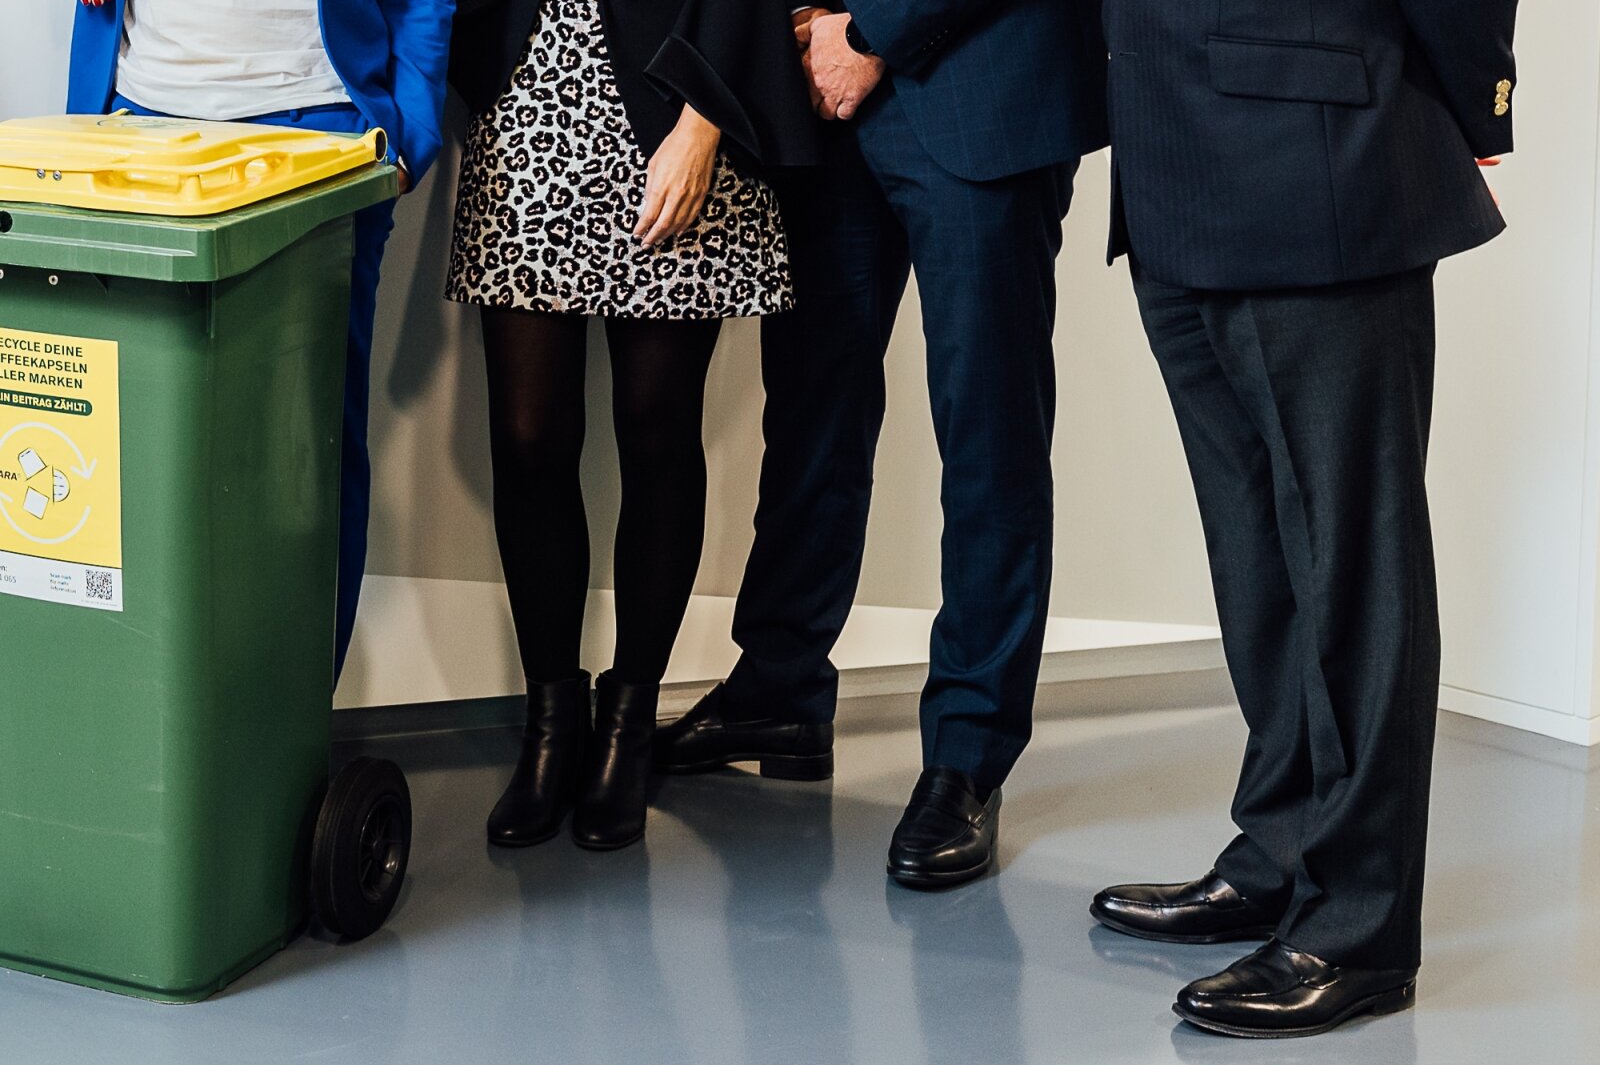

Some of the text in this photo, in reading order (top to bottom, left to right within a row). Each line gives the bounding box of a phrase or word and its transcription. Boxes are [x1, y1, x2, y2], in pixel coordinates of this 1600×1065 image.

[44, 343, 83, 357] DEINE
[29, 374, 82, 389] MARKEN
[12, 392, 52, 408] BEITRAG
[54, 397, 86, 412] ZÄHLT!
